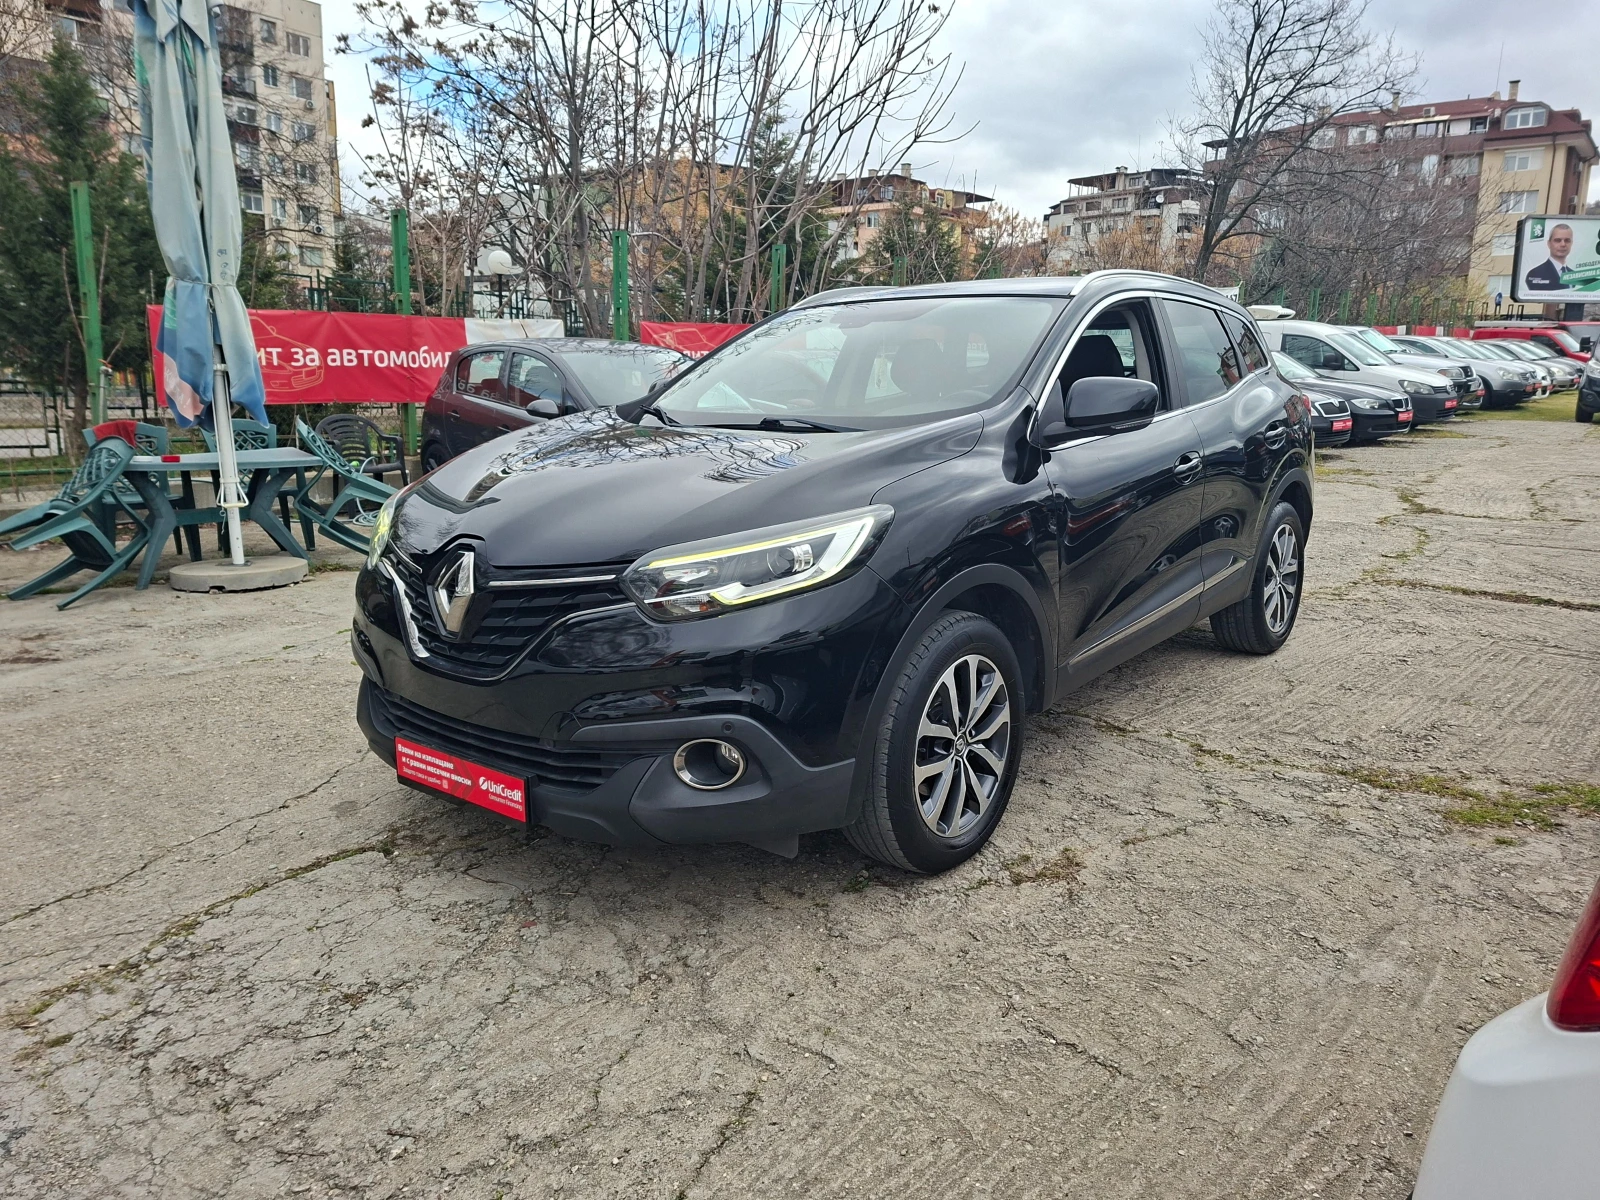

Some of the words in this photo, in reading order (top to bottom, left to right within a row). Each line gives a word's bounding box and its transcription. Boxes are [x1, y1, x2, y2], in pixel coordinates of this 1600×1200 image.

[290, 348, 321, 367] за
[398, 744, 414, 756] Вземи
[422, 753, 454, 770] изплащане
[410, 760, 426, 770] равни
[427, 765, 450, 779] месечни
[450, 774, 472, 786] вноски
[488, 780, 522, 802] UniCredit
[506, 799, 522, 812] Financing
